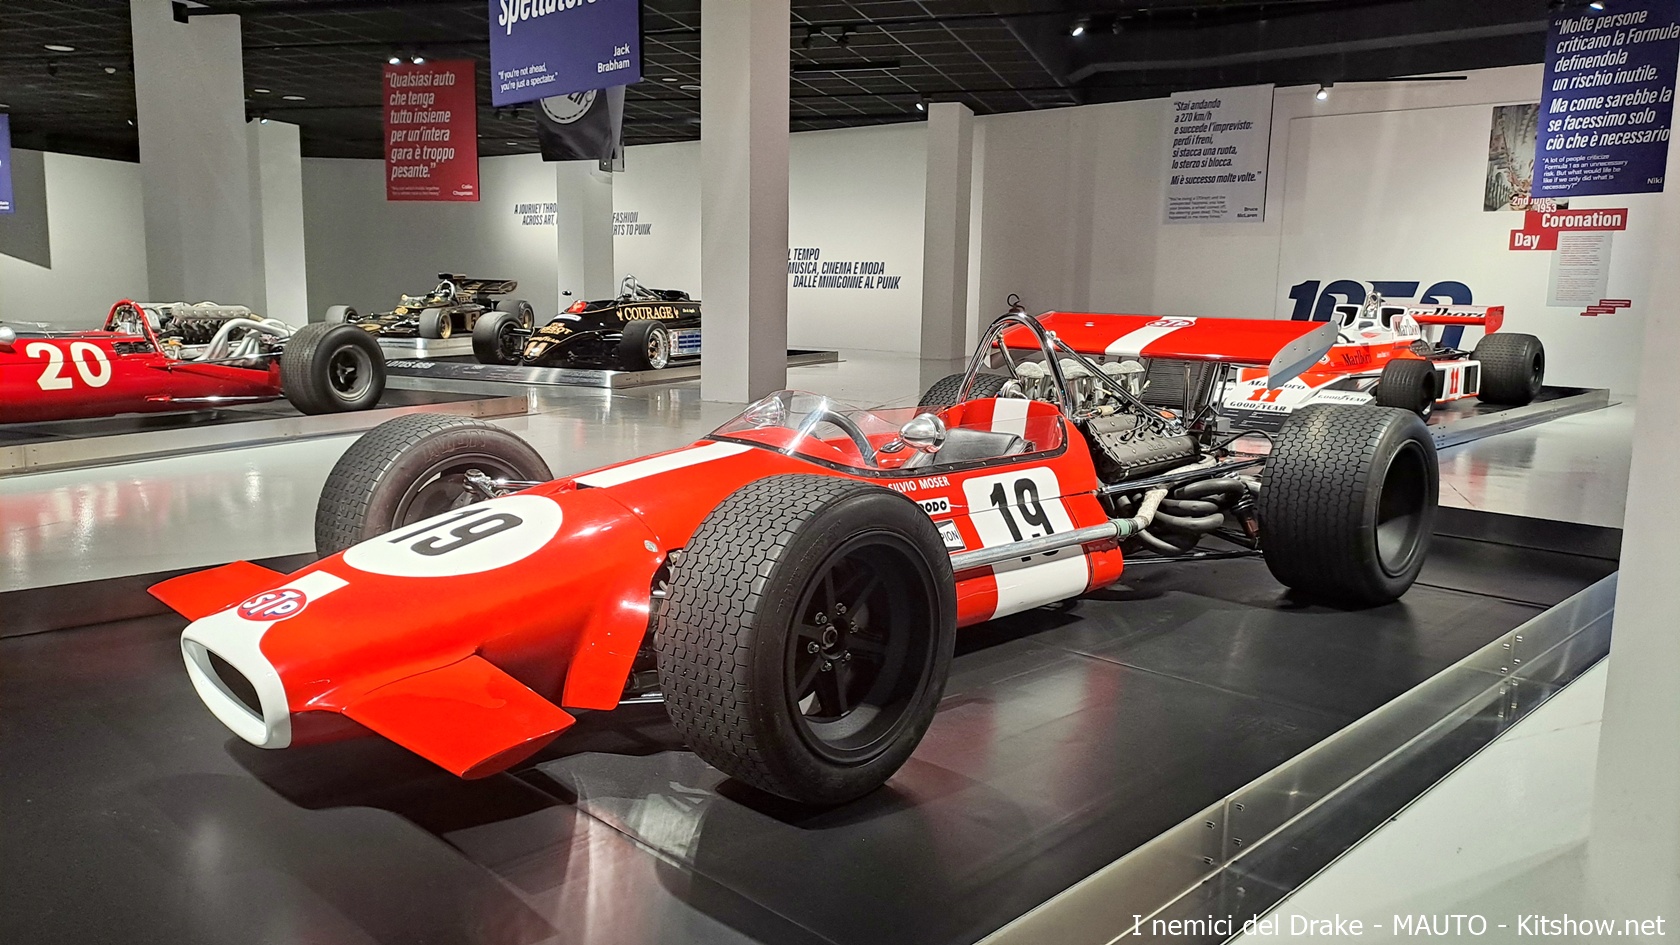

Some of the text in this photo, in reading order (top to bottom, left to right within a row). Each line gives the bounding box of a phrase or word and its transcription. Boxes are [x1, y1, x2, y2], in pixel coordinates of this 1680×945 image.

[1595, 10, 1648, 33] persone
[1556, 22, 1680, 54] criticano la Formula
[614, 43, 630, 57] Jack
[598, 59, 630, 73] Brabham
[1554, 48, 1628, 73] definendola
[433, 72, 455, 86] auto
[516, 78, 526, 90] just
[1552, 65, 1658, 91] un rischio inutile.
[390, 91, 434, 108] che tenga
[1190, 99, 1221, 110] andando
[1550, 86, 1672, 114] Ma come sarebbe la
[390, 108, 450, 124] tutto insieme
[1180, 113, 1192, 122] 270
[1194, 111, 1212, 121] km/h
[1547, 108, 1656, 132] se facessimo solo
[1179, 123, 1207, 134] succede
[390, 130, 406, 145] per
[1173, 136, 1191, 148] perdi
[1546, 126, 1670, 151] ciò che è necessario
[391, 144, 454, 163] gara è troppo
[1173, 145, 1237, 158] si stacca una ruota,
[1172, 157, 1232, 169] lo sterzo si blocca.
[1566, 155, 1585, 164] people
[1171, 175, 1179, 185] Mi
[1180, 175, 1184, 184] è
[1185, 174, 1216, 184] successo
[1216, 172, 1237, 182] molte
[1512, 196, 1529, 206] 2nd
[1537, 203, 1557, 213] 1953
[514, 204, 518, 214] A
[519, 204, 541, 214] JOURNEY
[522, 215, 543, 225] ACROSS
[613, 212, 638, 223] FASHION
[1542, 212, 1621, 227] Coronation
[626, 224, 634, 235] TO
[635, 224, 652, 235] PUNK
[1514, 233, 1540, 250] Day
[794, 248, 820, 260] TEMPO
[788, 262, 885, 275] MUSICA, CINEMA E MODA
[793, 276, 901, 289] DALLE MINIGONNE AL PUNK
[624, 307, 674, 320] COURAGE
[26, 341, 112, 391] 20
[1248, 380, 1306, 390] Maoro
[1247, 388, 1283, 402] 11
[918, 476, 950, 490] MOSER
[990, 478, 1059, 562] 19
[387, 507, 523, 556] 19
[242, 591, 302, 615] STP
